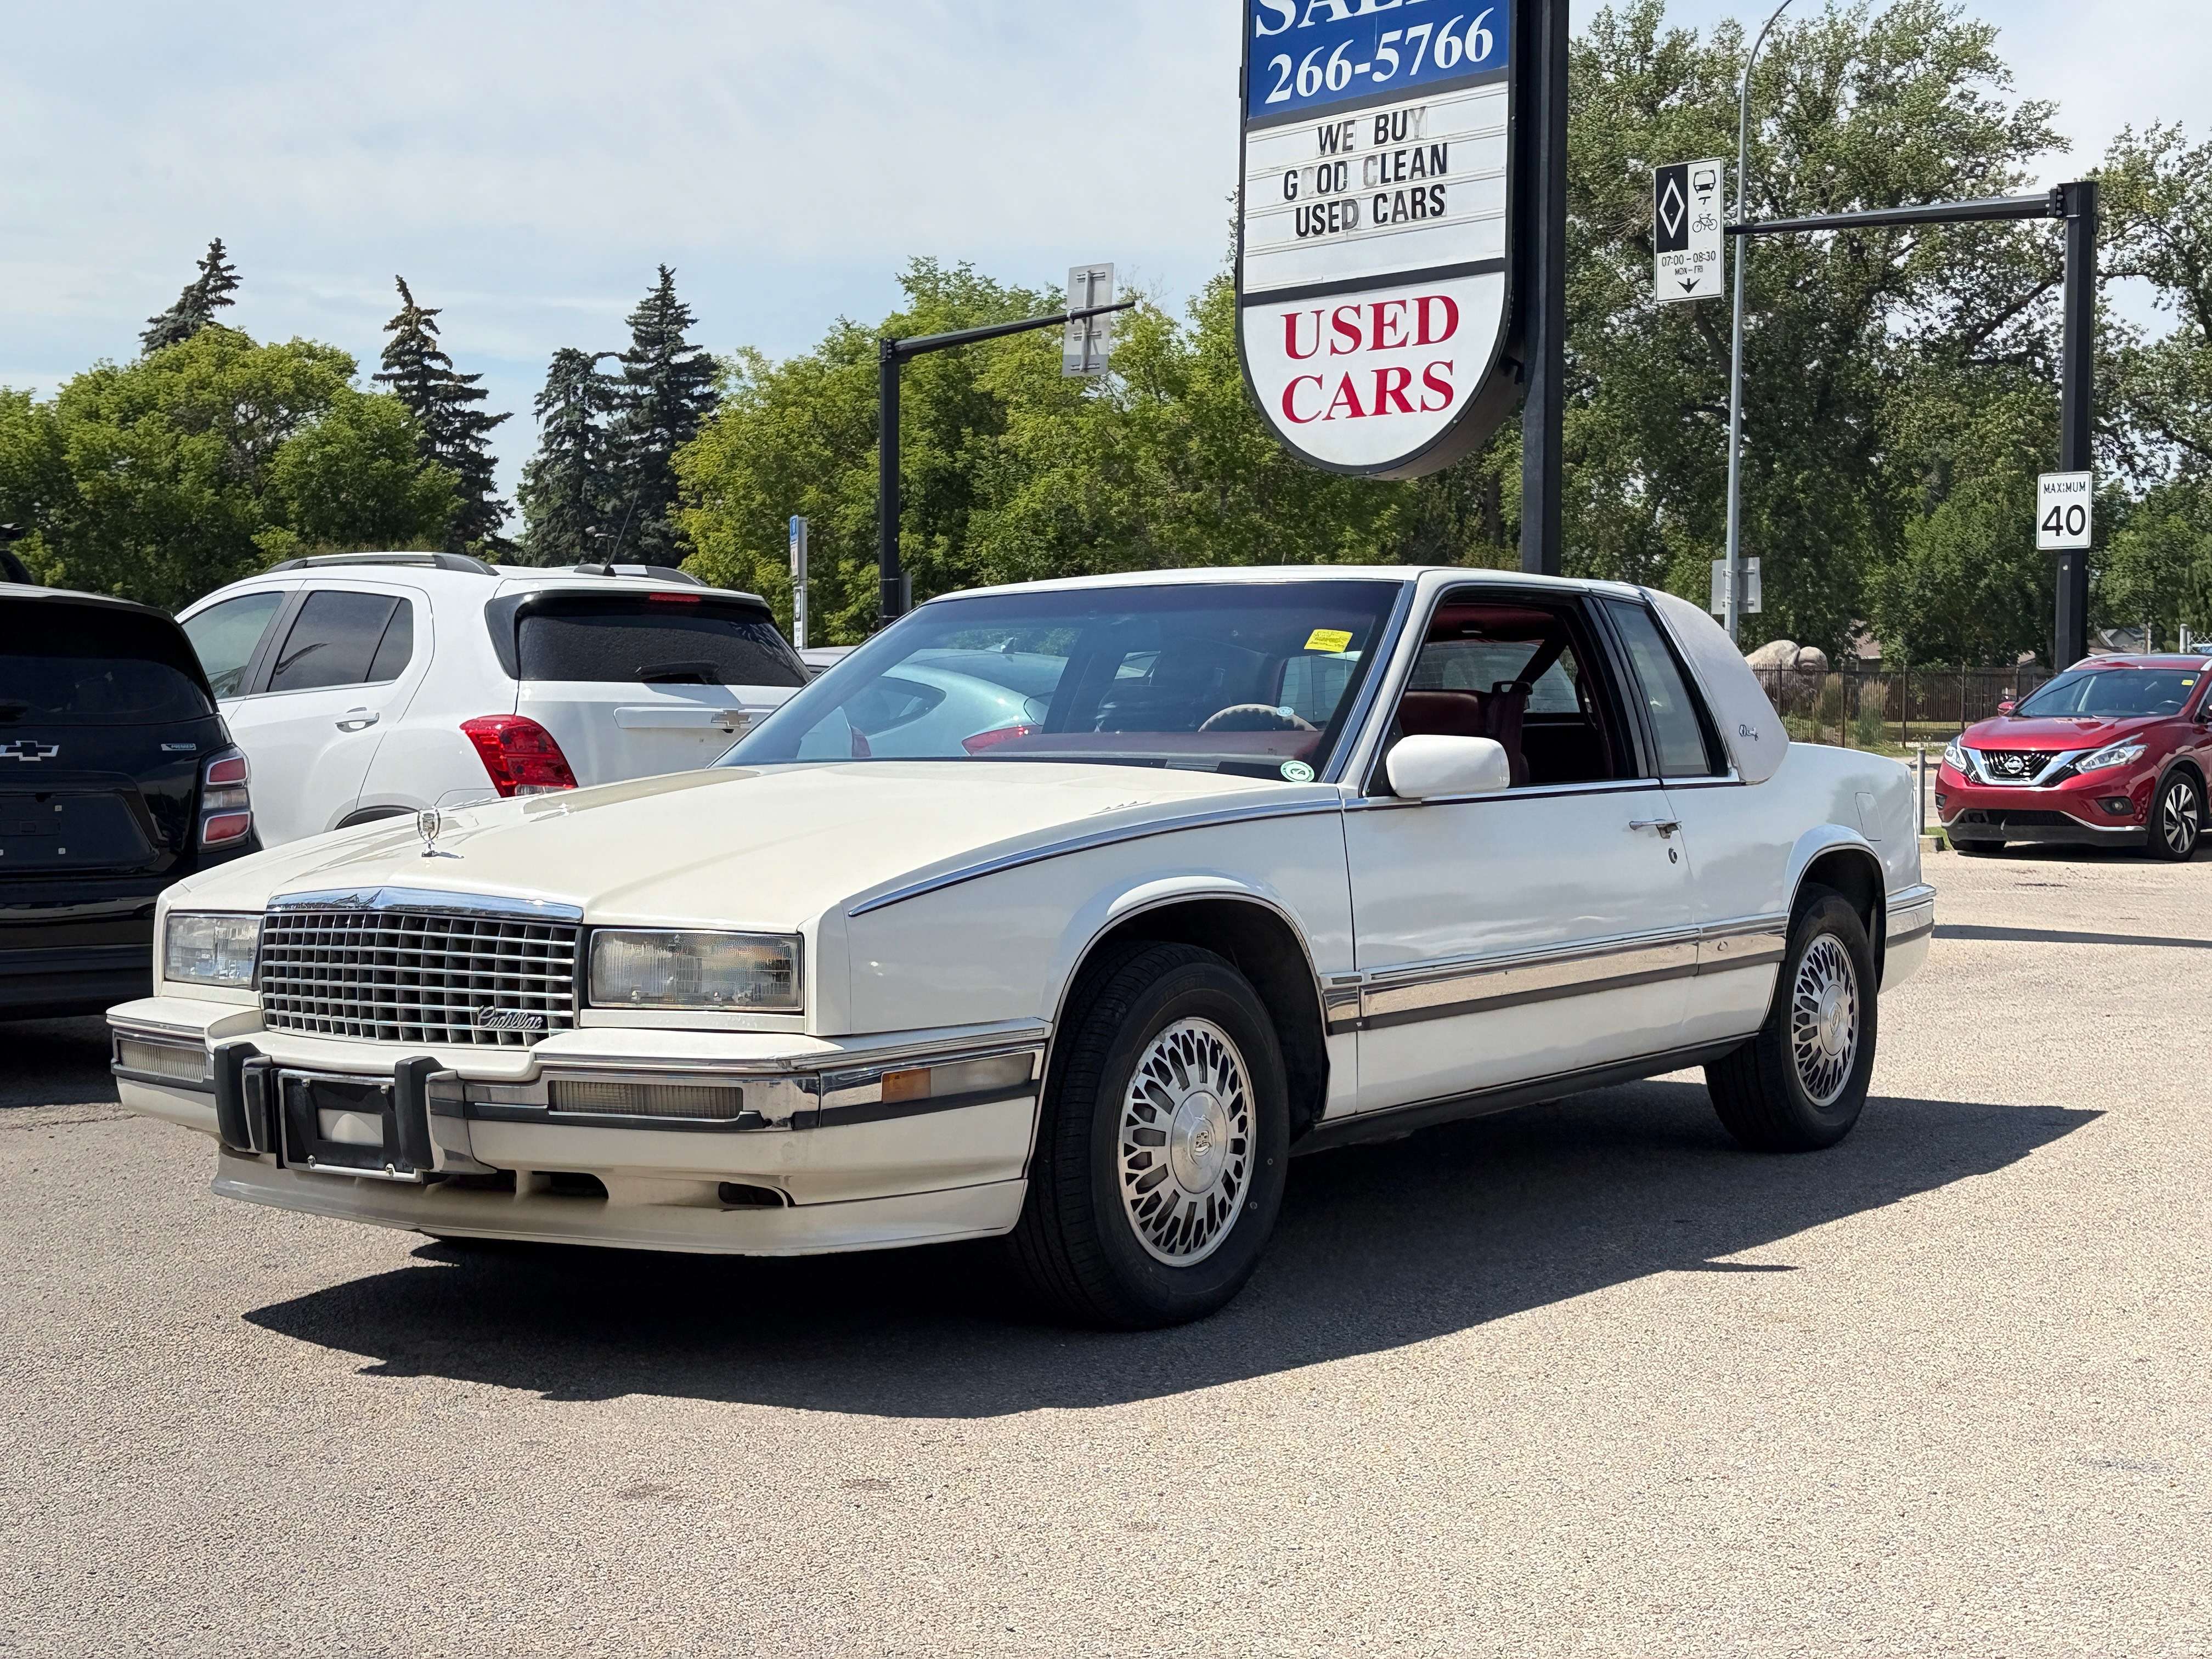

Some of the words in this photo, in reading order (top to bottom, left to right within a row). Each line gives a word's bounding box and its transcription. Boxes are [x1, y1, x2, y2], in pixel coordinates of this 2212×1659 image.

[1265, 7, 1494, 104] 266-5766
[1318, 120, 1355, 156] WE
[1374, 106, 1426, 145] BUY
[1284, 161, 1348, 201] GOD
[1363, 143, 1447, 189] CLEAN
[1296, 199, 1359, 237] USED
[1373, 184, 1445, 224] CARS
[1662, 255, 1684, 267] 07:00
[1280, 295, 1459, 359] USED
[1282, 359, 1454, 424] CARS
[2044, 481, 2086, 494] MAXIMUM
[2042, 505, 2086, 536] 40
[477, 1005, 543, 1029] Cadillac
